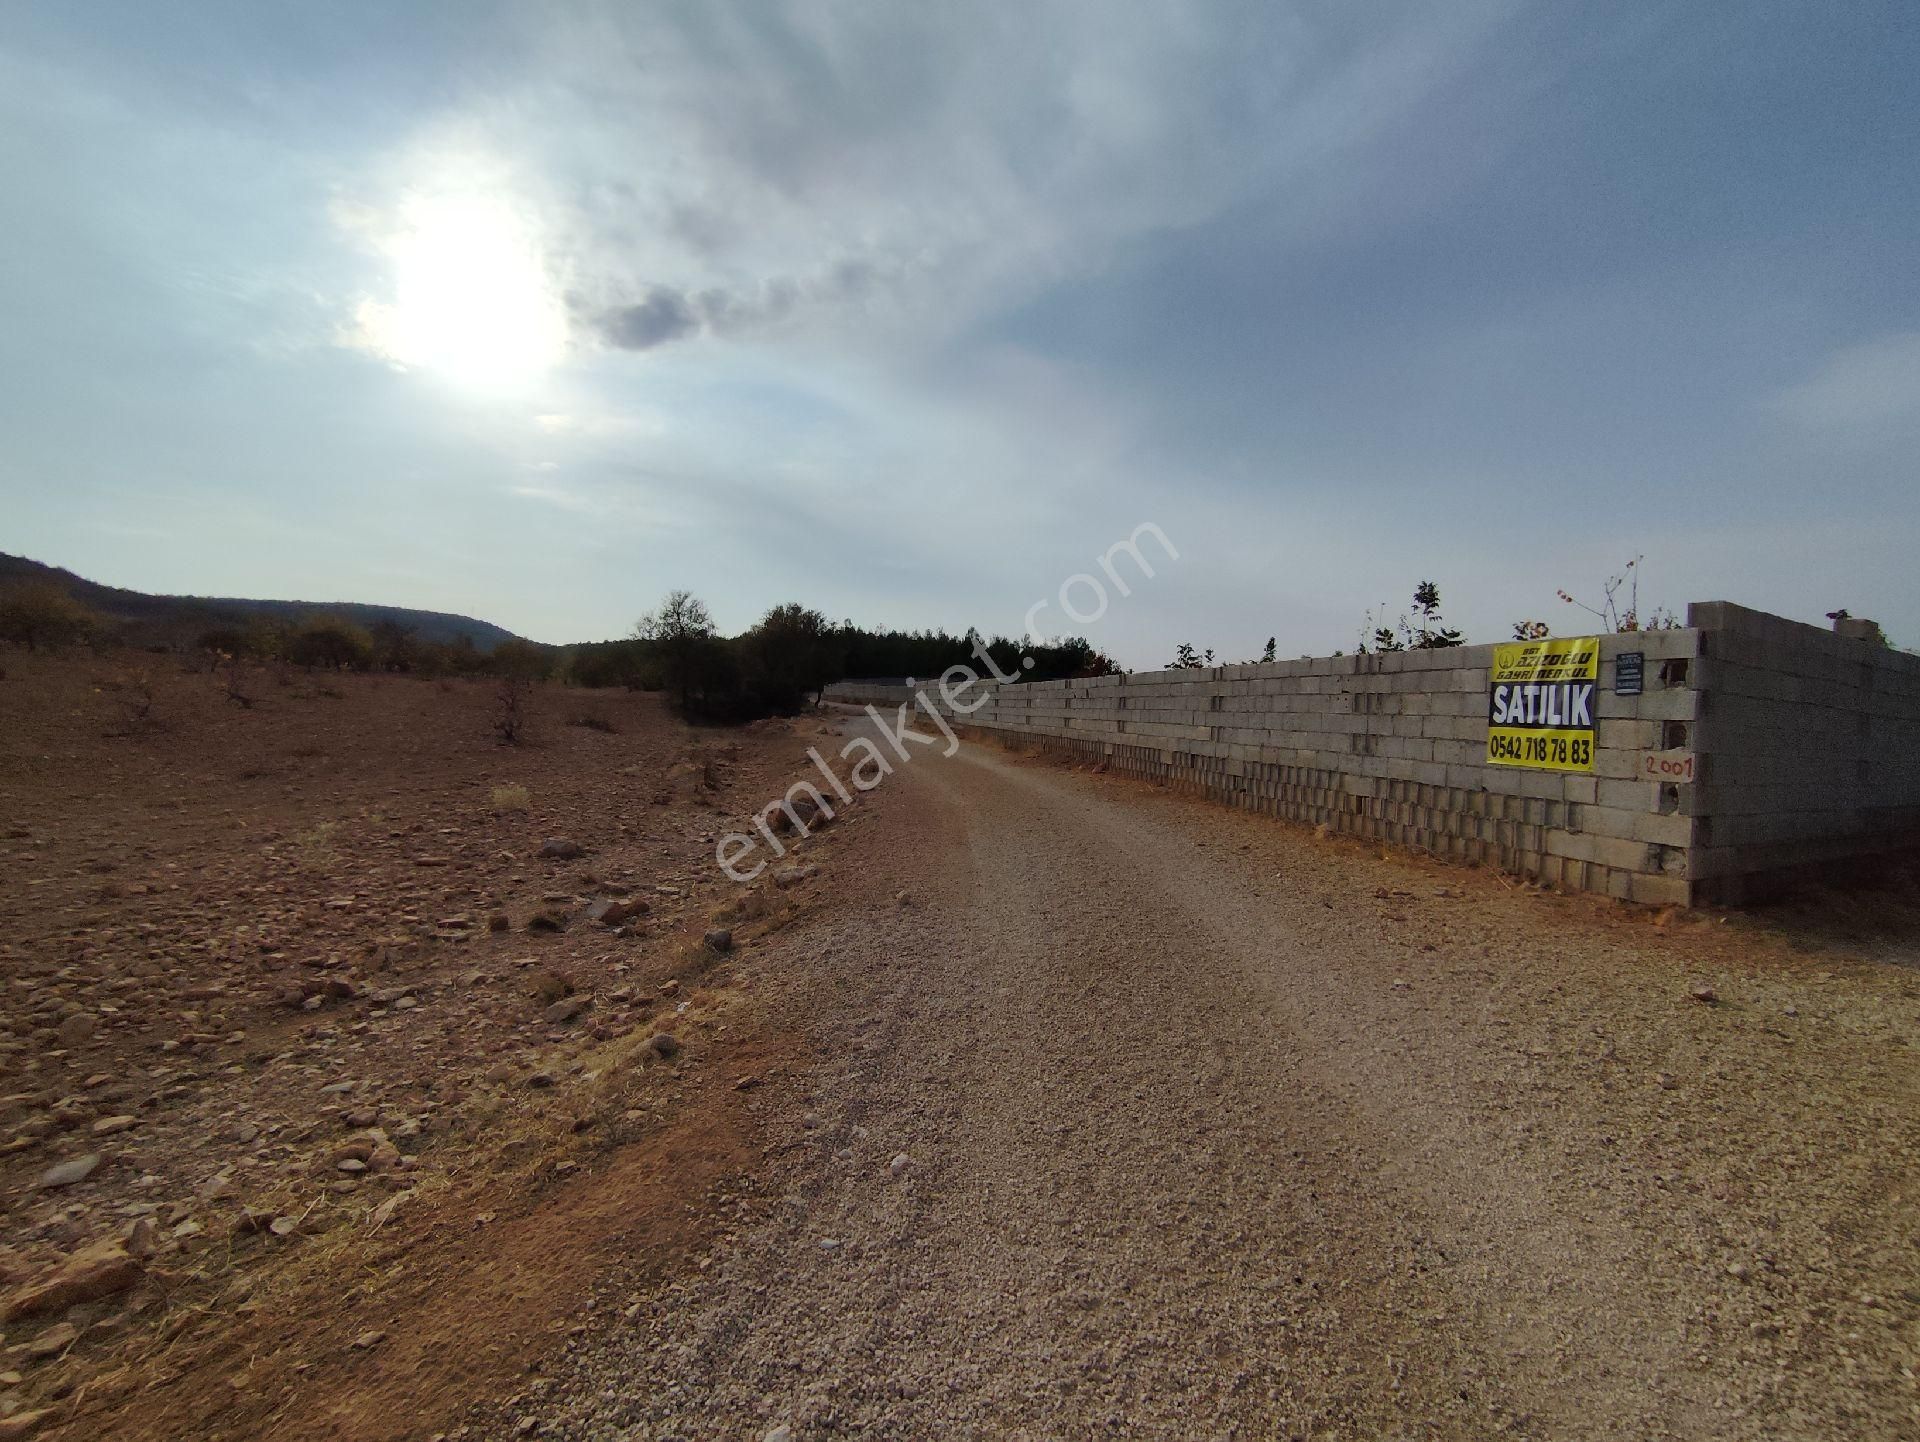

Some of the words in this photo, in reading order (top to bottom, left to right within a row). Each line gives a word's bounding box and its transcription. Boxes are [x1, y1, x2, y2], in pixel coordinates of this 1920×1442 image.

[1492, 684, 1593, 726] SATILIK
[1490, 735, 1522, 760] 0542
[1525, 736, 1547, 761] 718
[1551, 738, 1567, 764] 78
[1571, 739, 1590, 765] 83
